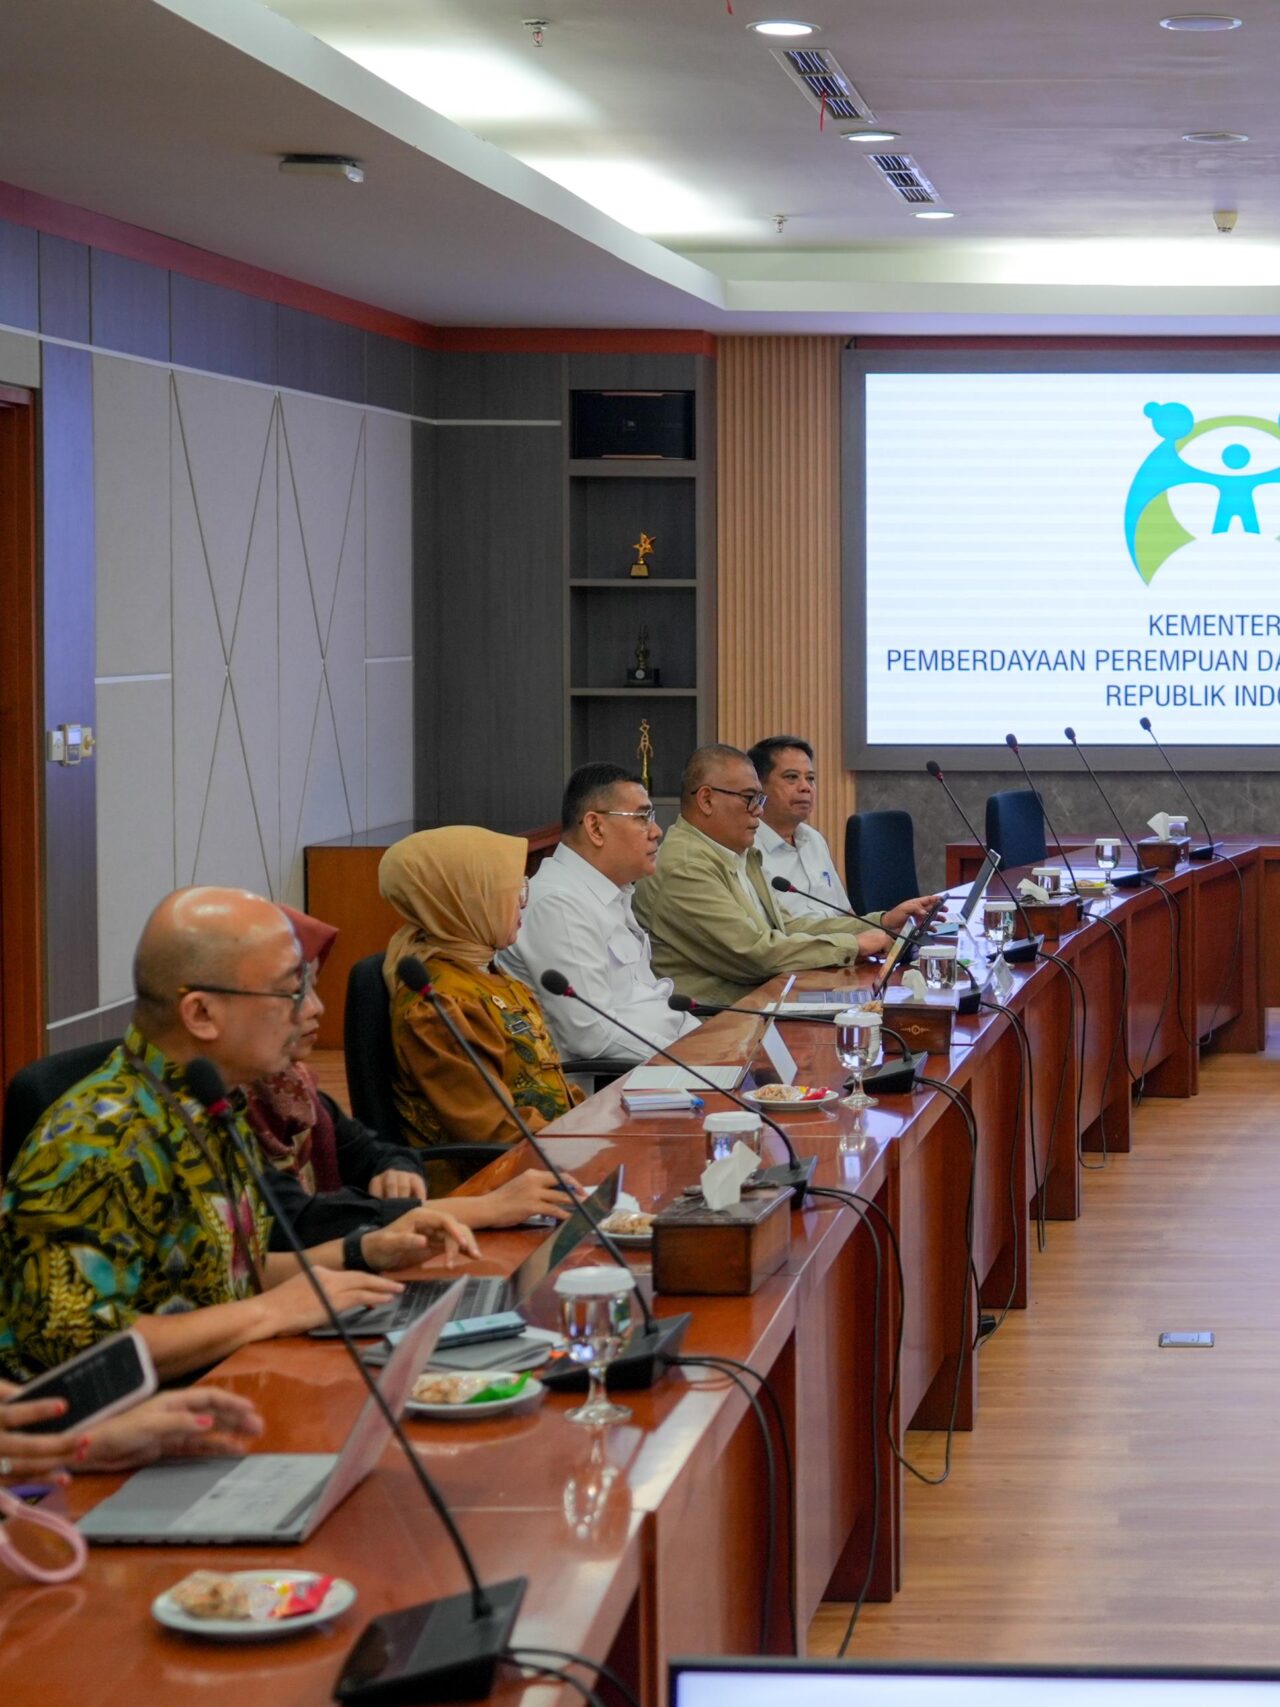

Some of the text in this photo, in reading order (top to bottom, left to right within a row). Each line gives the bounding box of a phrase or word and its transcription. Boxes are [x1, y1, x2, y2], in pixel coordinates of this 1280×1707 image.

[887, 649, 1086, 672] PEMBERDAYAAN
[1095, 649, 1248, 672] PEREMPUAN
[1106, 684, 1226, 707] REPUBLIK
